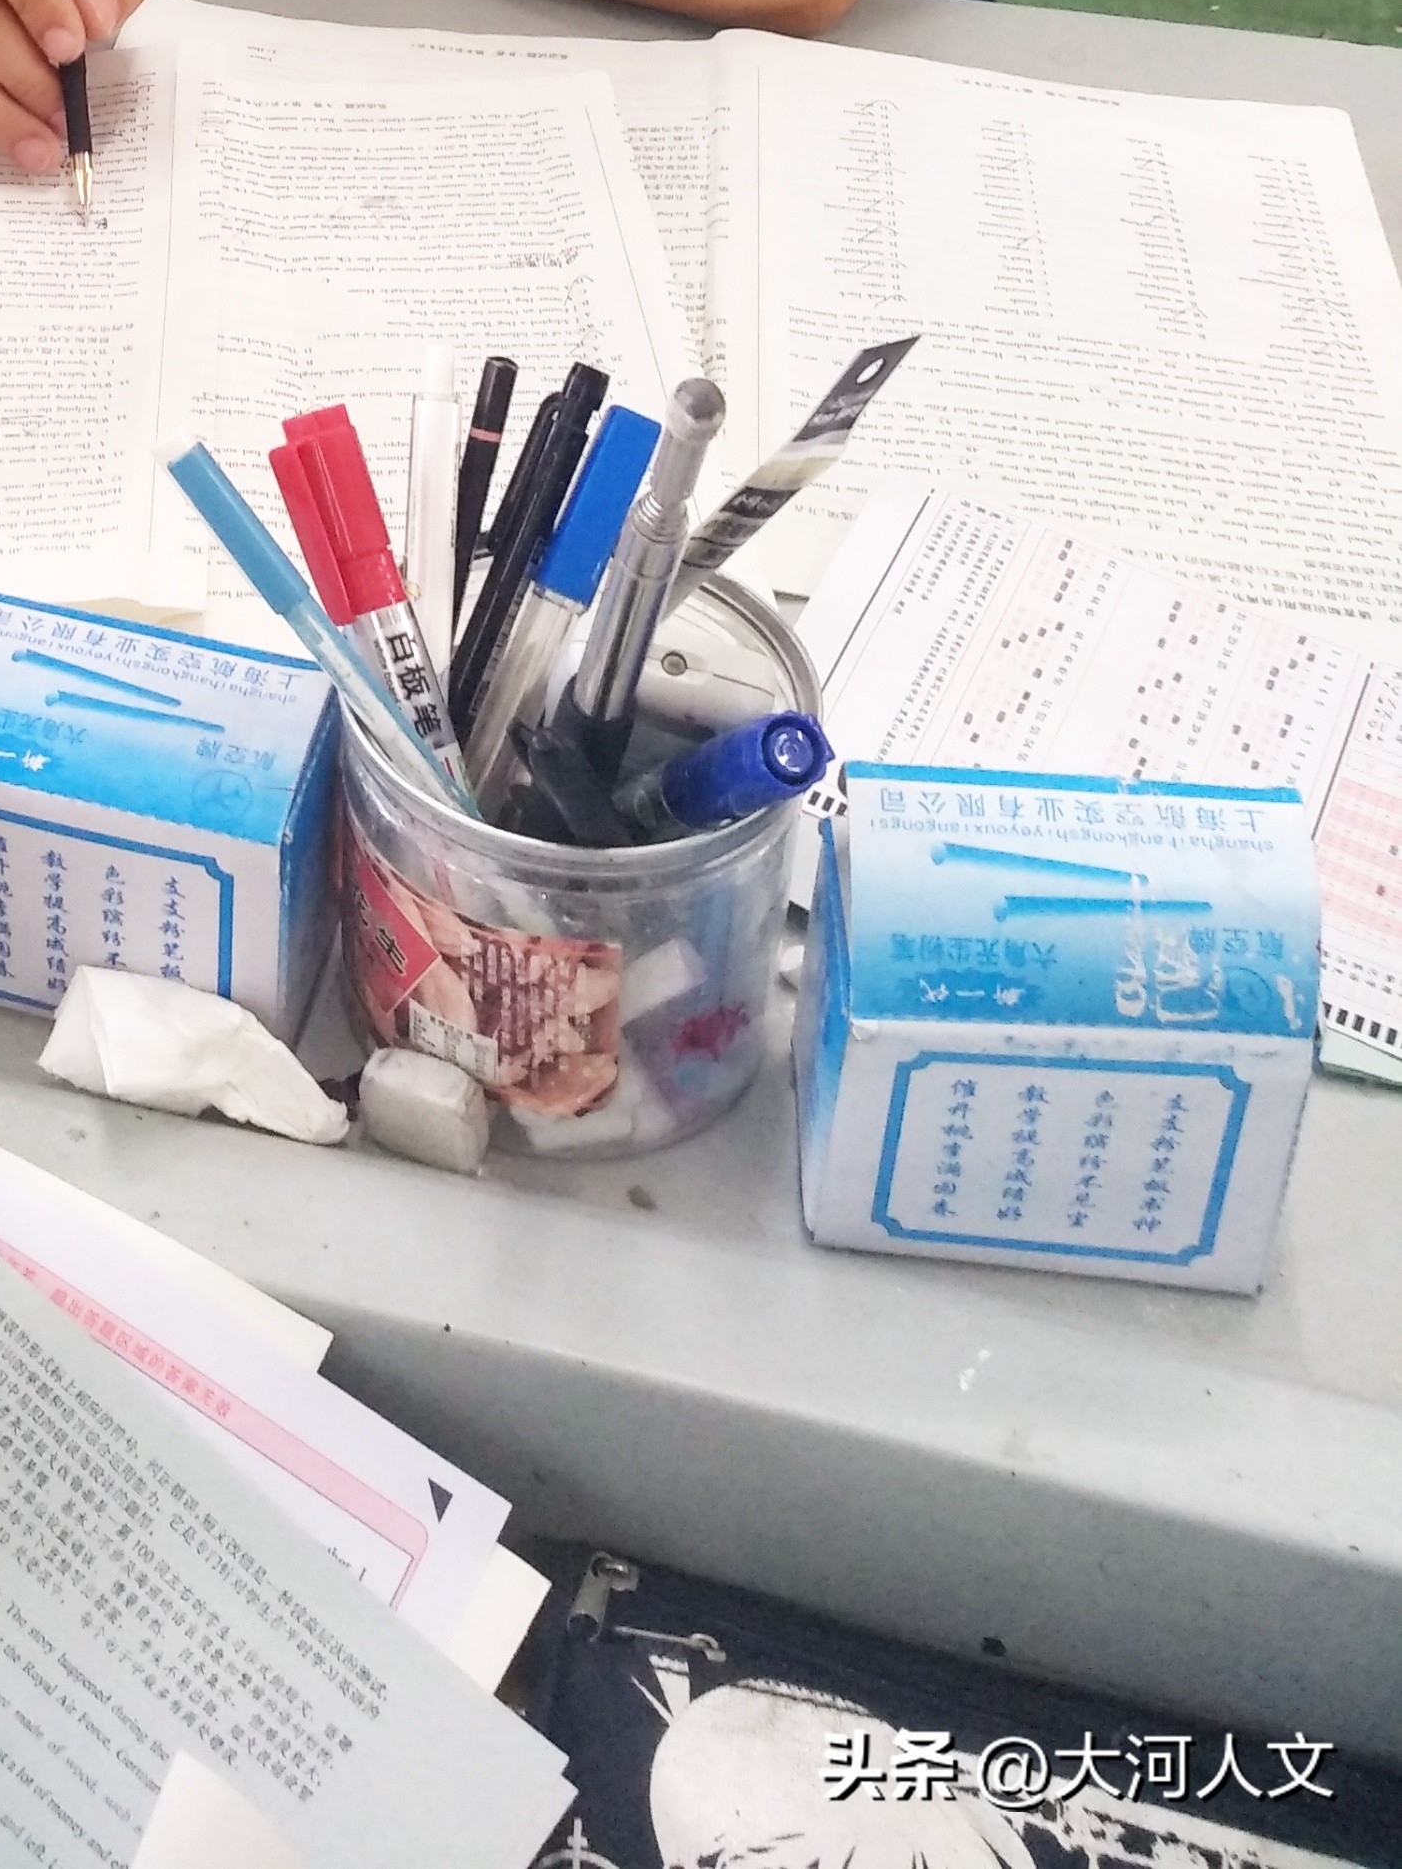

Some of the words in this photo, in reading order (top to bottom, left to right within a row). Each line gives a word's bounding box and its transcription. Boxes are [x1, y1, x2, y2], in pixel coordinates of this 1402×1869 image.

[877, 786, 1265, 834] 上海航空实业有限公司
